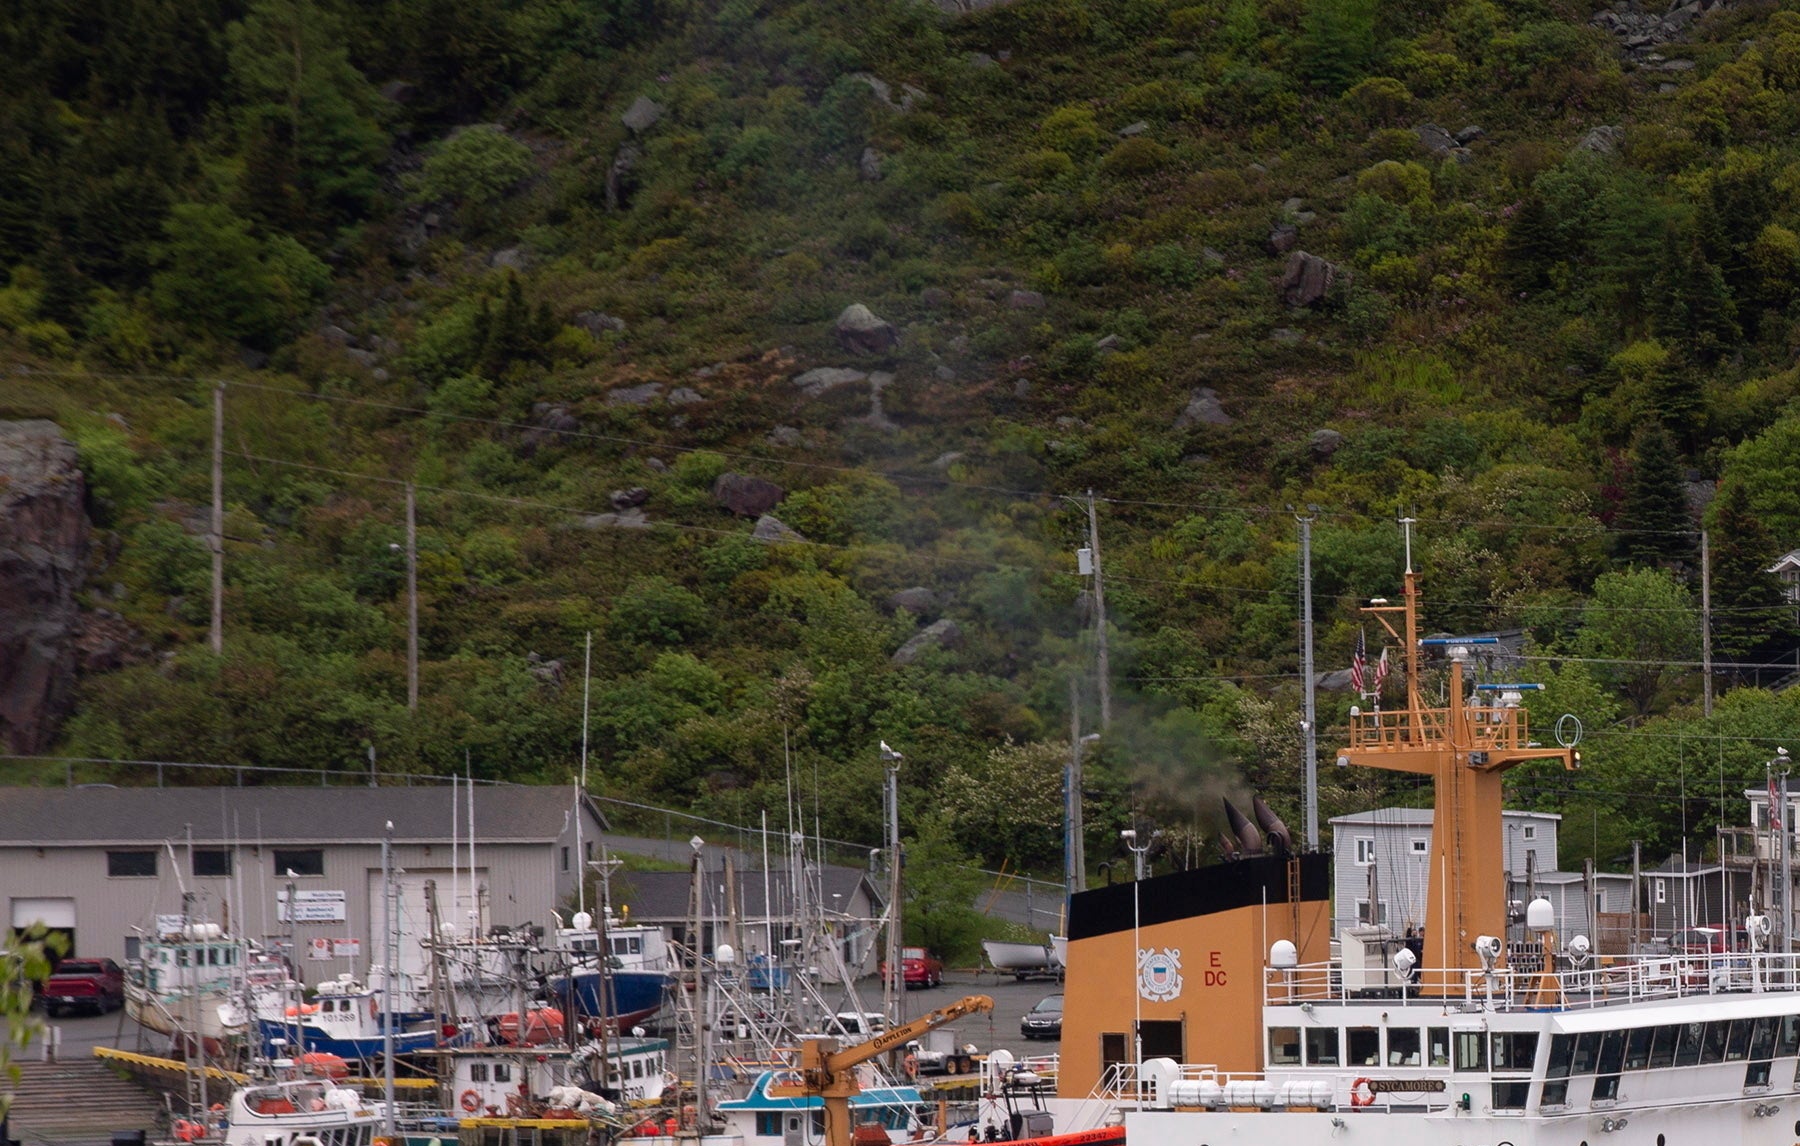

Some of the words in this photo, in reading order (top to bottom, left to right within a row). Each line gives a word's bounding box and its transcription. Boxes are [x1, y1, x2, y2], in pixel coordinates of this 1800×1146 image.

[1210, 952, 1222, 968] E
[1204, 970, 1227, 987] DC
[882, 1027, 912, 1043] APPLETON
[1379, 1081, 1435, 1091] SYCAMORE
[1080, 1132, 1107, 1142] 22347
